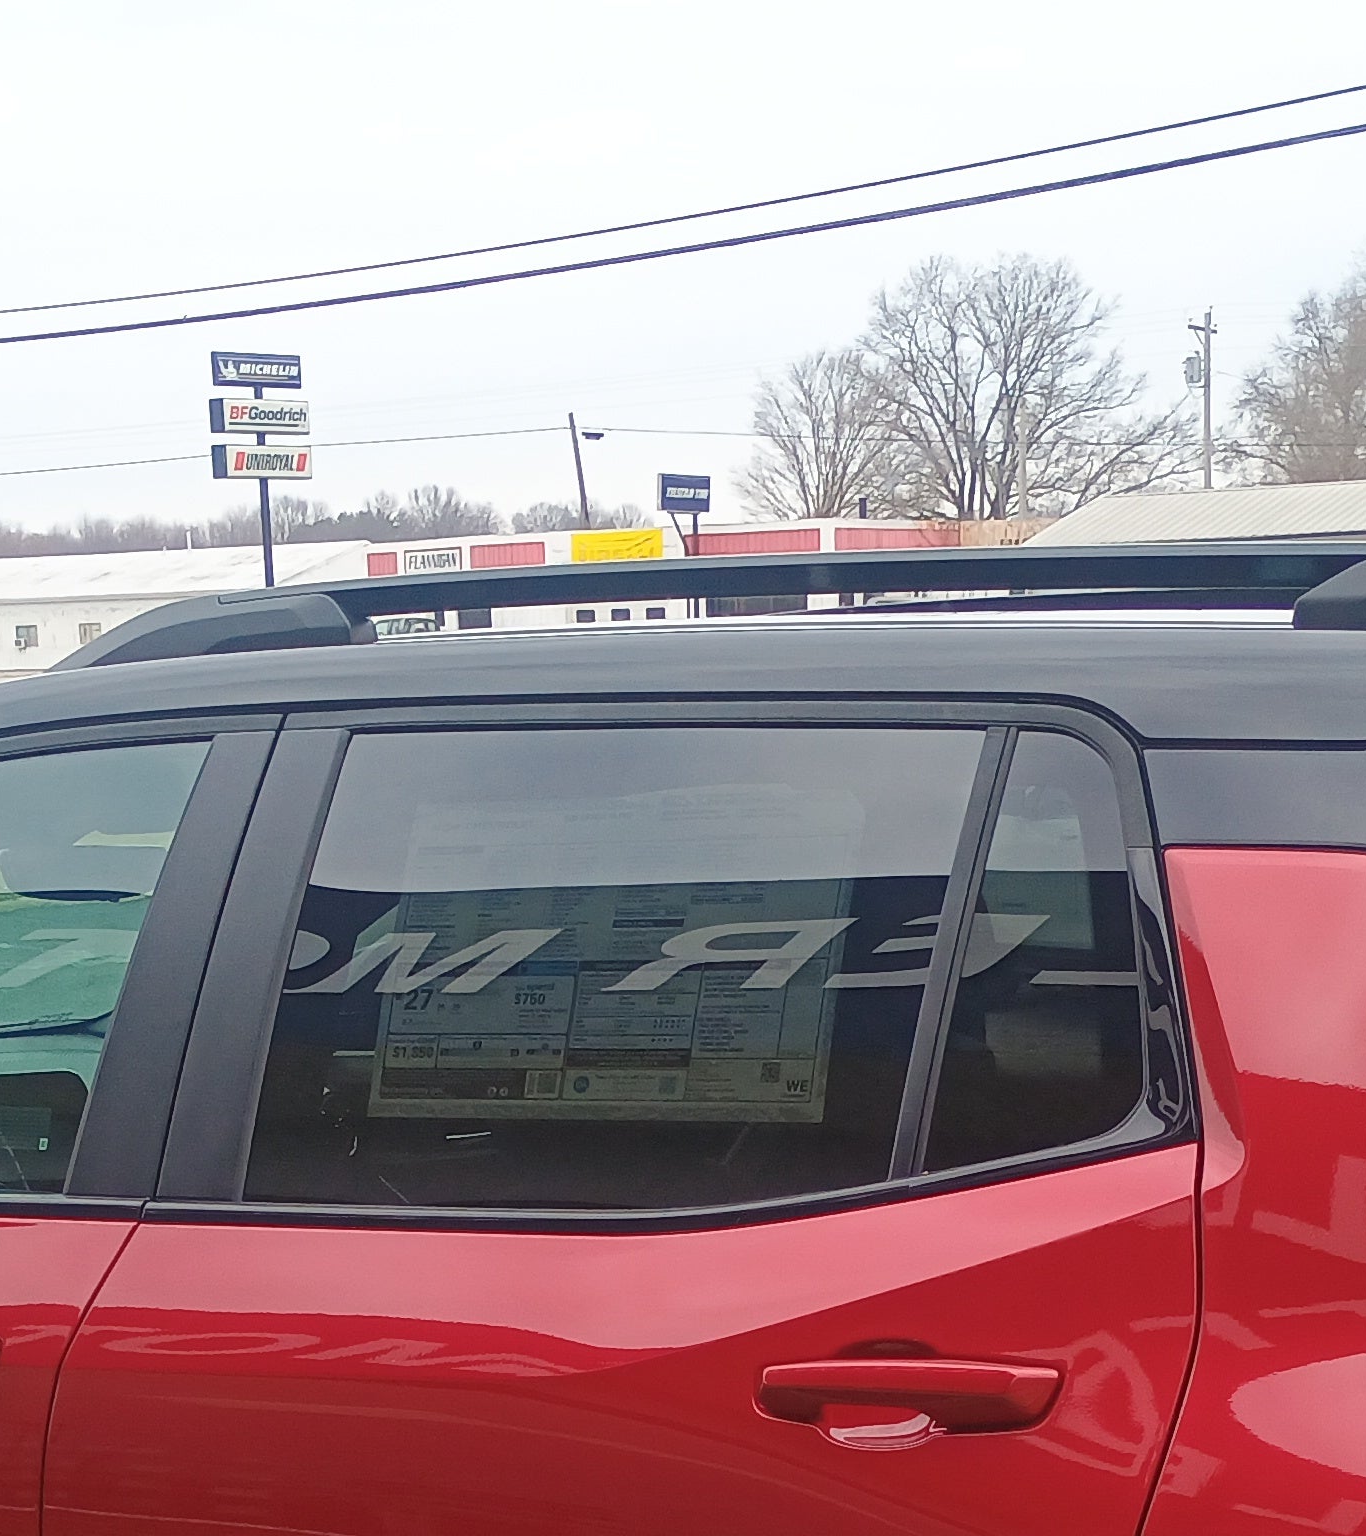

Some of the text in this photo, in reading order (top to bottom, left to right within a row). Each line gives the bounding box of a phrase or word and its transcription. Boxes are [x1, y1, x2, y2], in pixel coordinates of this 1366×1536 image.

[239, 363, 299, 377] MICHELIN
[229, 405, 307, 423] BFGoodrich
[245, 453, 295, 471] UNIROYAL
